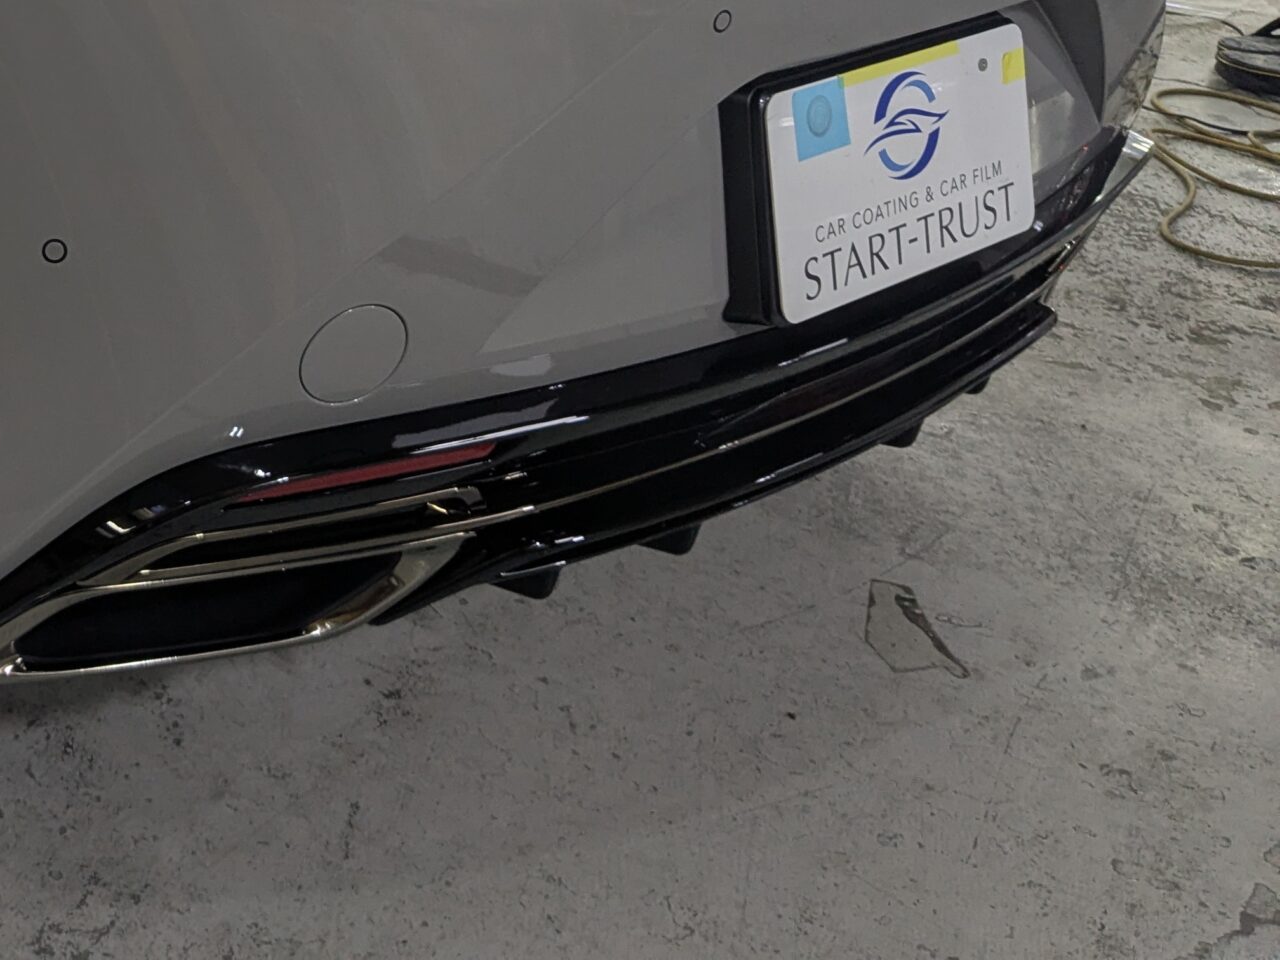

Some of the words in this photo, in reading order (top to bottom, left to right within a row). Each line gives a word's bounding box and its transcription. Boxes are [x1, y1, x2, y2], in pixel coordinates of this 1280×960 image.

[804, 182, 1015, 301] START-TRUST
[815, 219, 846, 243] CAR
[852, 191, 919, 229] COATING
[925, 187, 935, 203] &
[940, 173, 968, 197] CAR
[972, 160, 1003, 185] FILM
